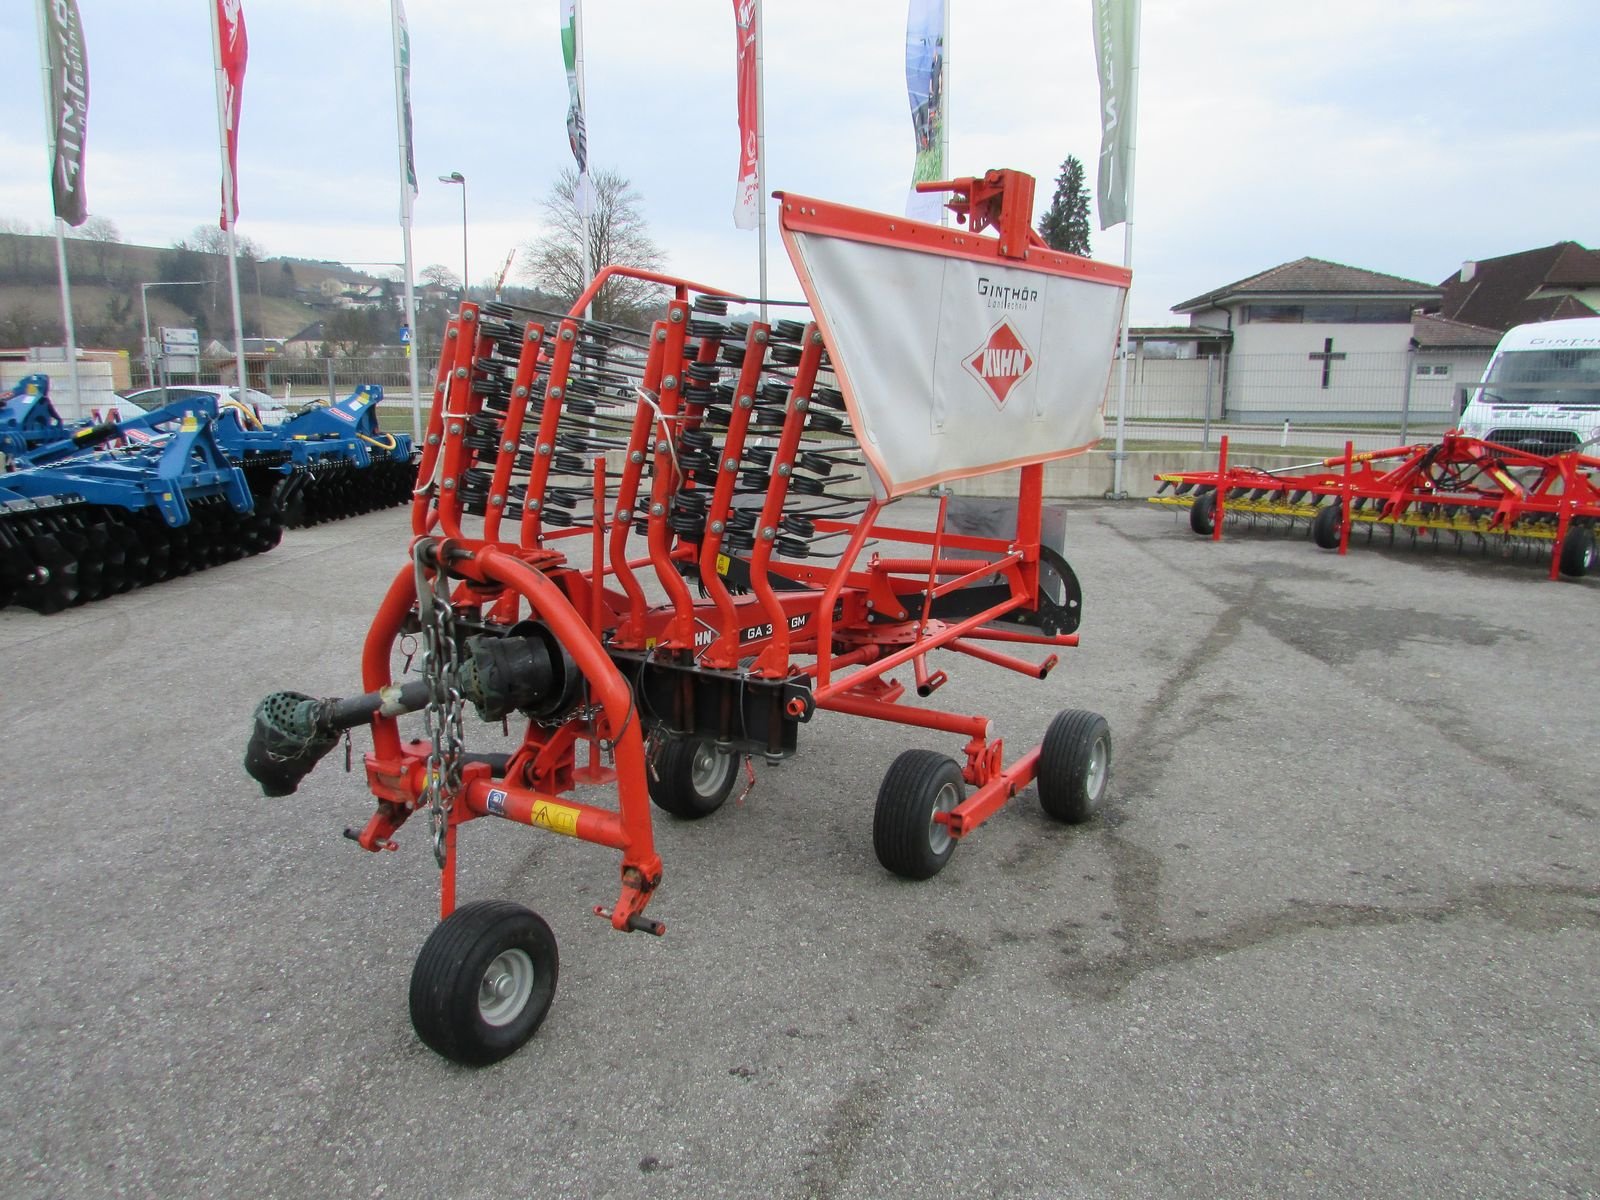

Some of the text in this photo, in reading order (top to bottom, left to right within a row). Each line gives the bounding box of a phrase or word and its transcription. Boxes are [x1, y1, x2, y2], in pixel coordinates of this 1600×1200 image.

[1529, 337, 1600, 346] GINTH
[981, 348, 1027, 377] KUHN
[747, 626, 763, 640] GA
[791, 615, 806, 628] GM
[694, 630, 712, 646] HN
